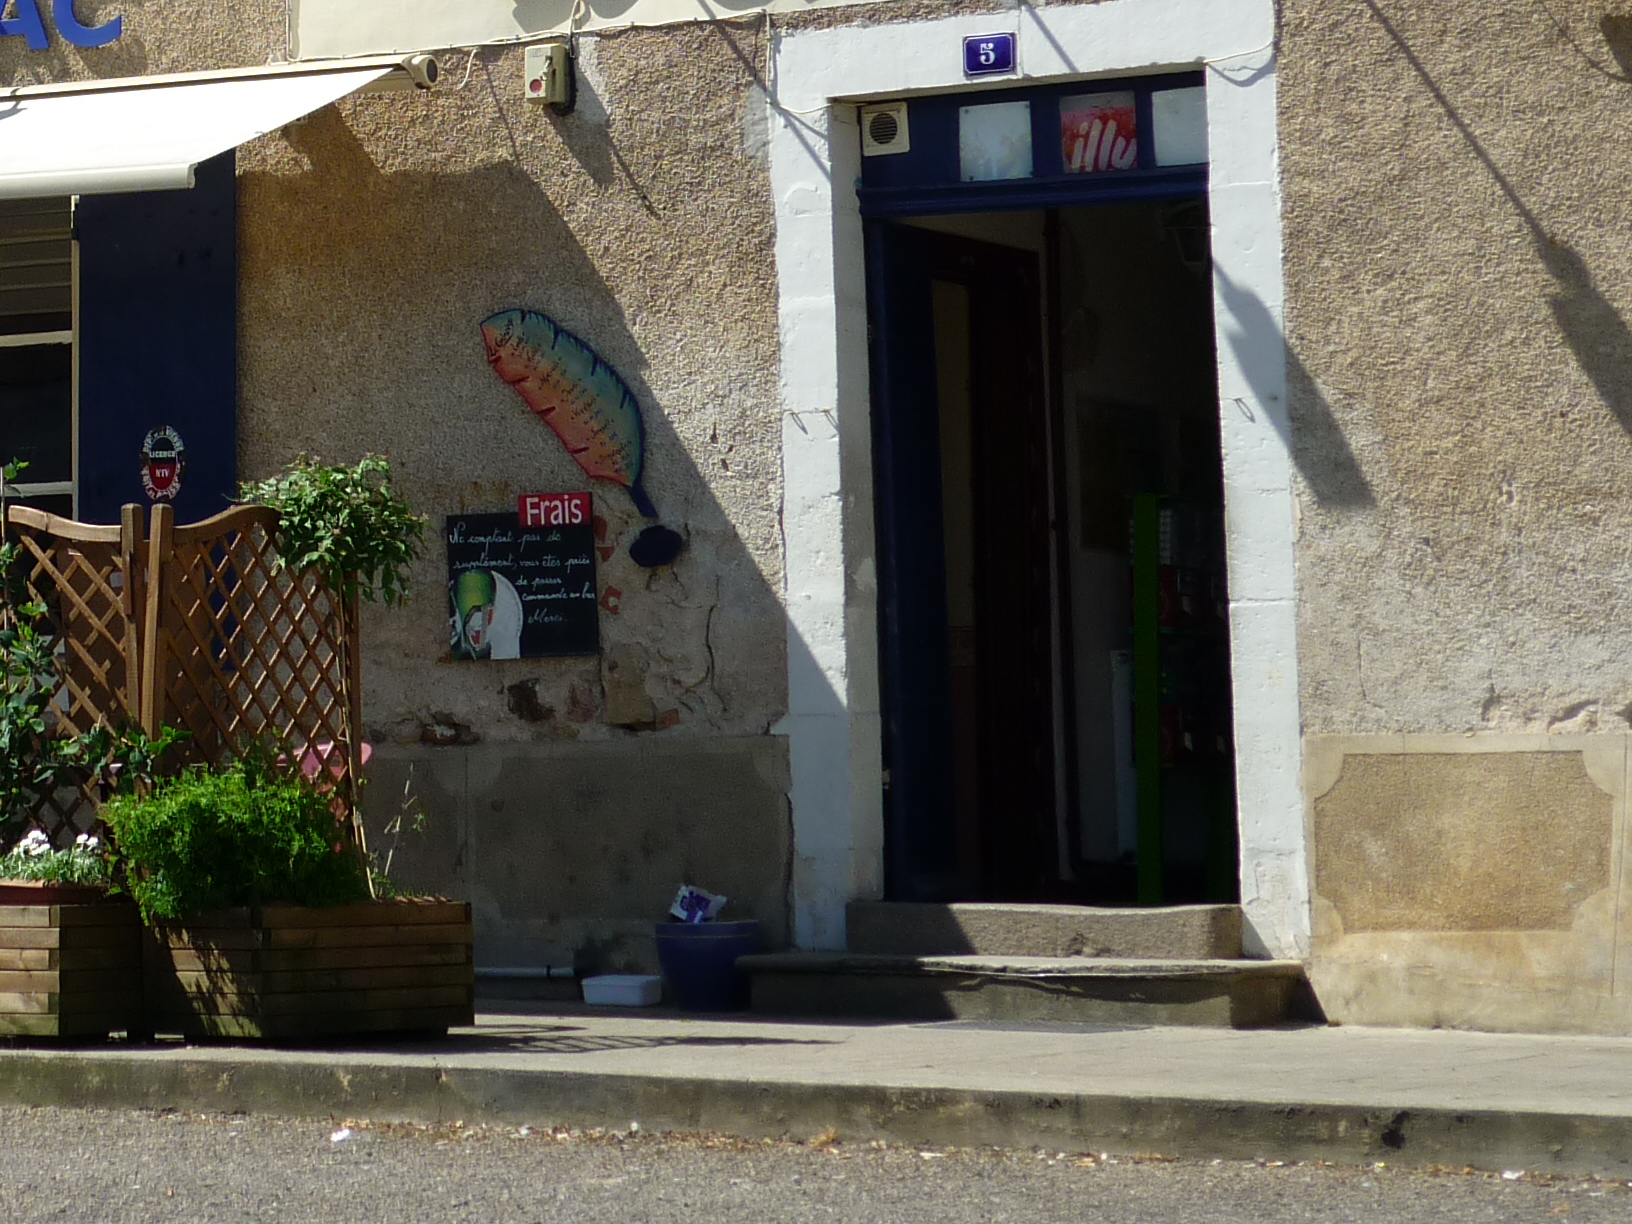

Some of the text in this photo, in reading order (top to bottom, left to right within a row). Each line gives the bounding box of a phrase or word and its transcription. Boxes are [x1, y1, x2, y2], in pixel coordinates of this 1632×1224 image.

[979, 42, 996, 66] 5
[525, 494, 583, 526] Frais
[518, 535, 541, 553] pas
